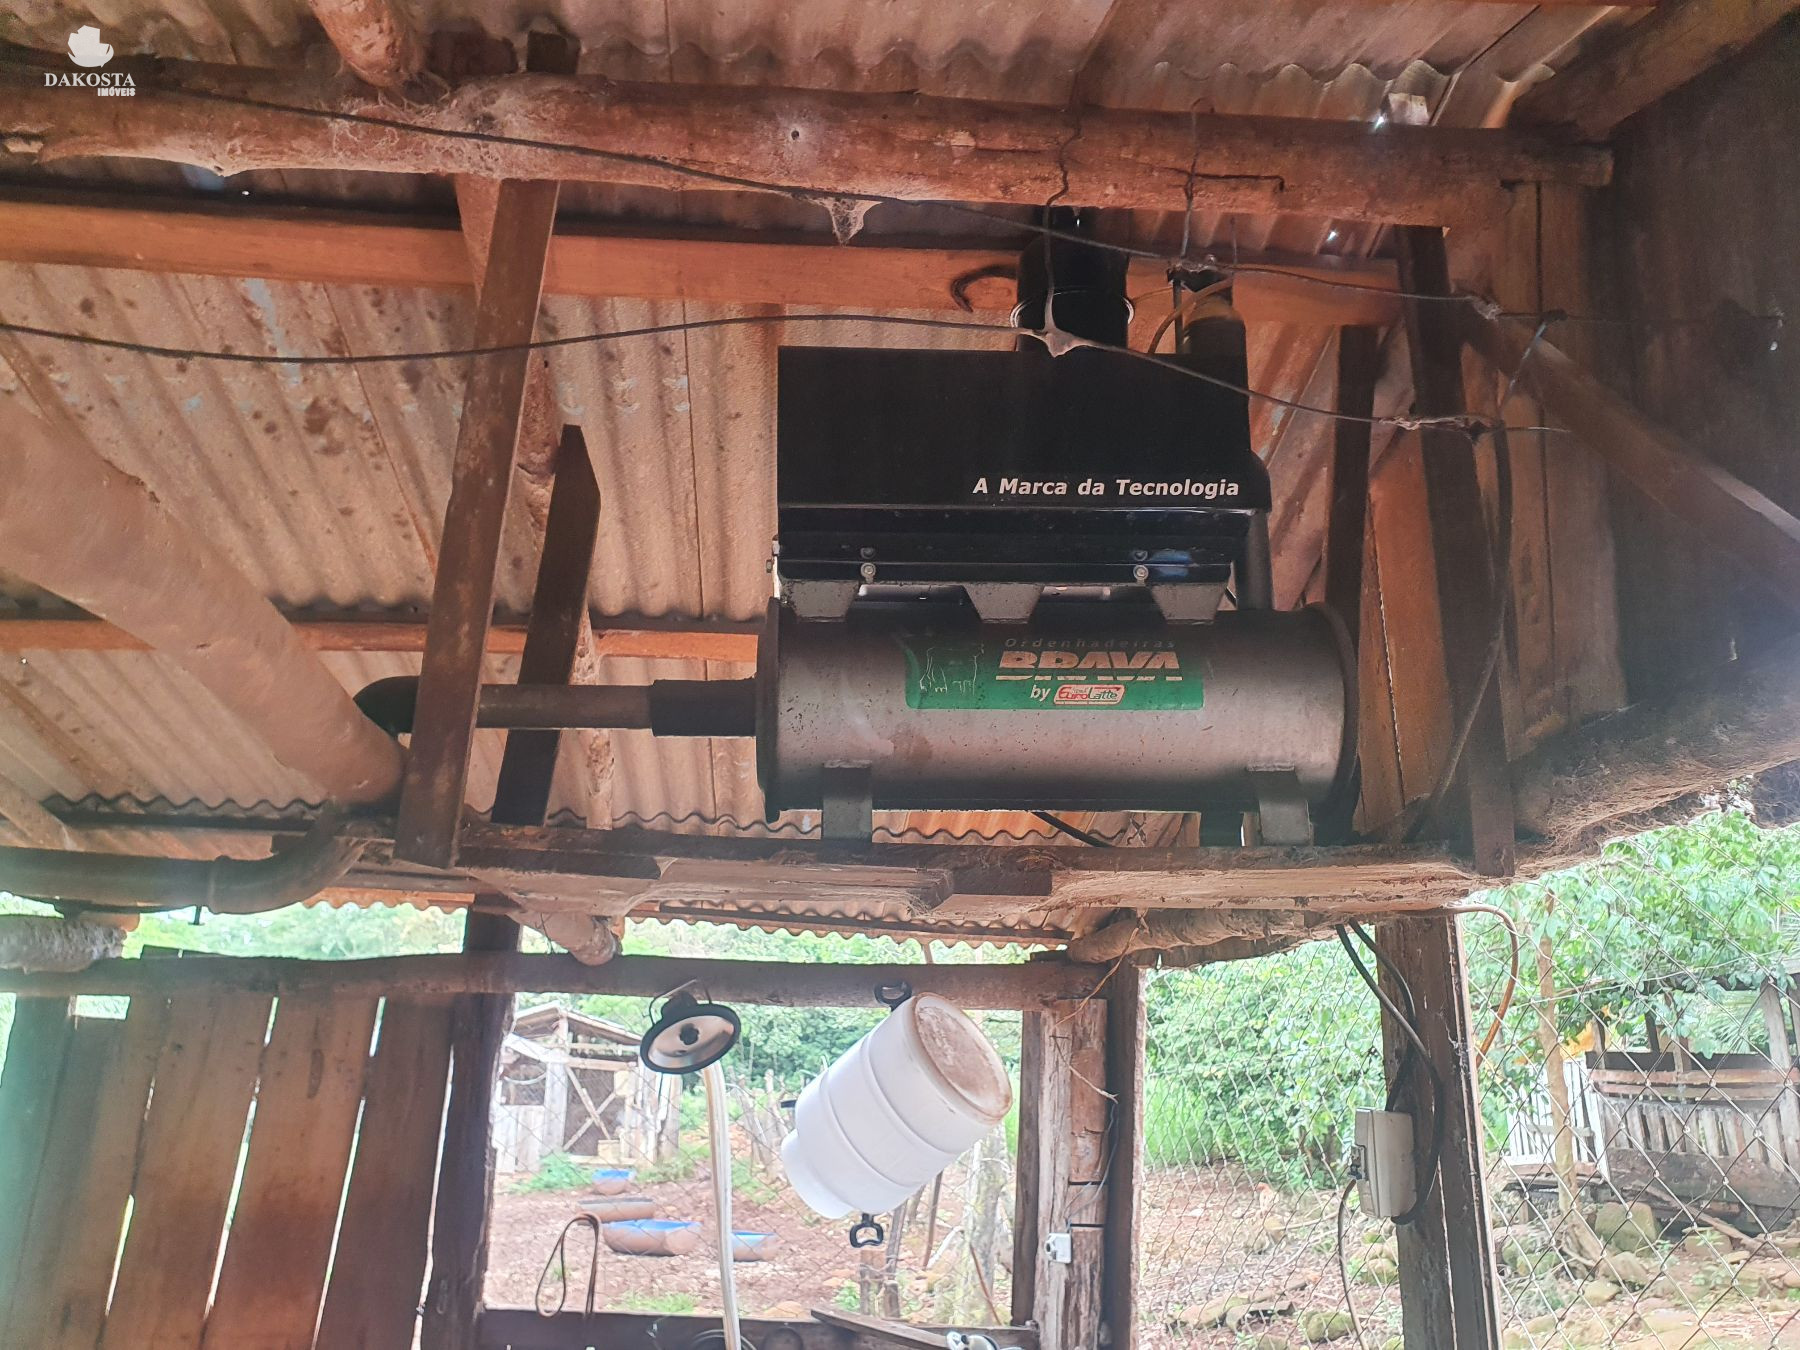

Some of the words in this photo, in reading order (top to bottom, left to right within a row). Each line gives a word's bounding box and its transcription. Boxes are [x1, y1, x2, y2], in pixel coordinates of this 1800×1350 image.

[972, 477, 989, 494] A
[998, 478, 1068, 495] Marca
[1077, 478, 1105, 495] da
[1116, 478, 1240, 500] Tecnologia
[1004, 638, 1177, 649] Ordenhadeiras
[995, 650, 1183, 681] BRAVA
[1030, 684, 1051, 702] by
